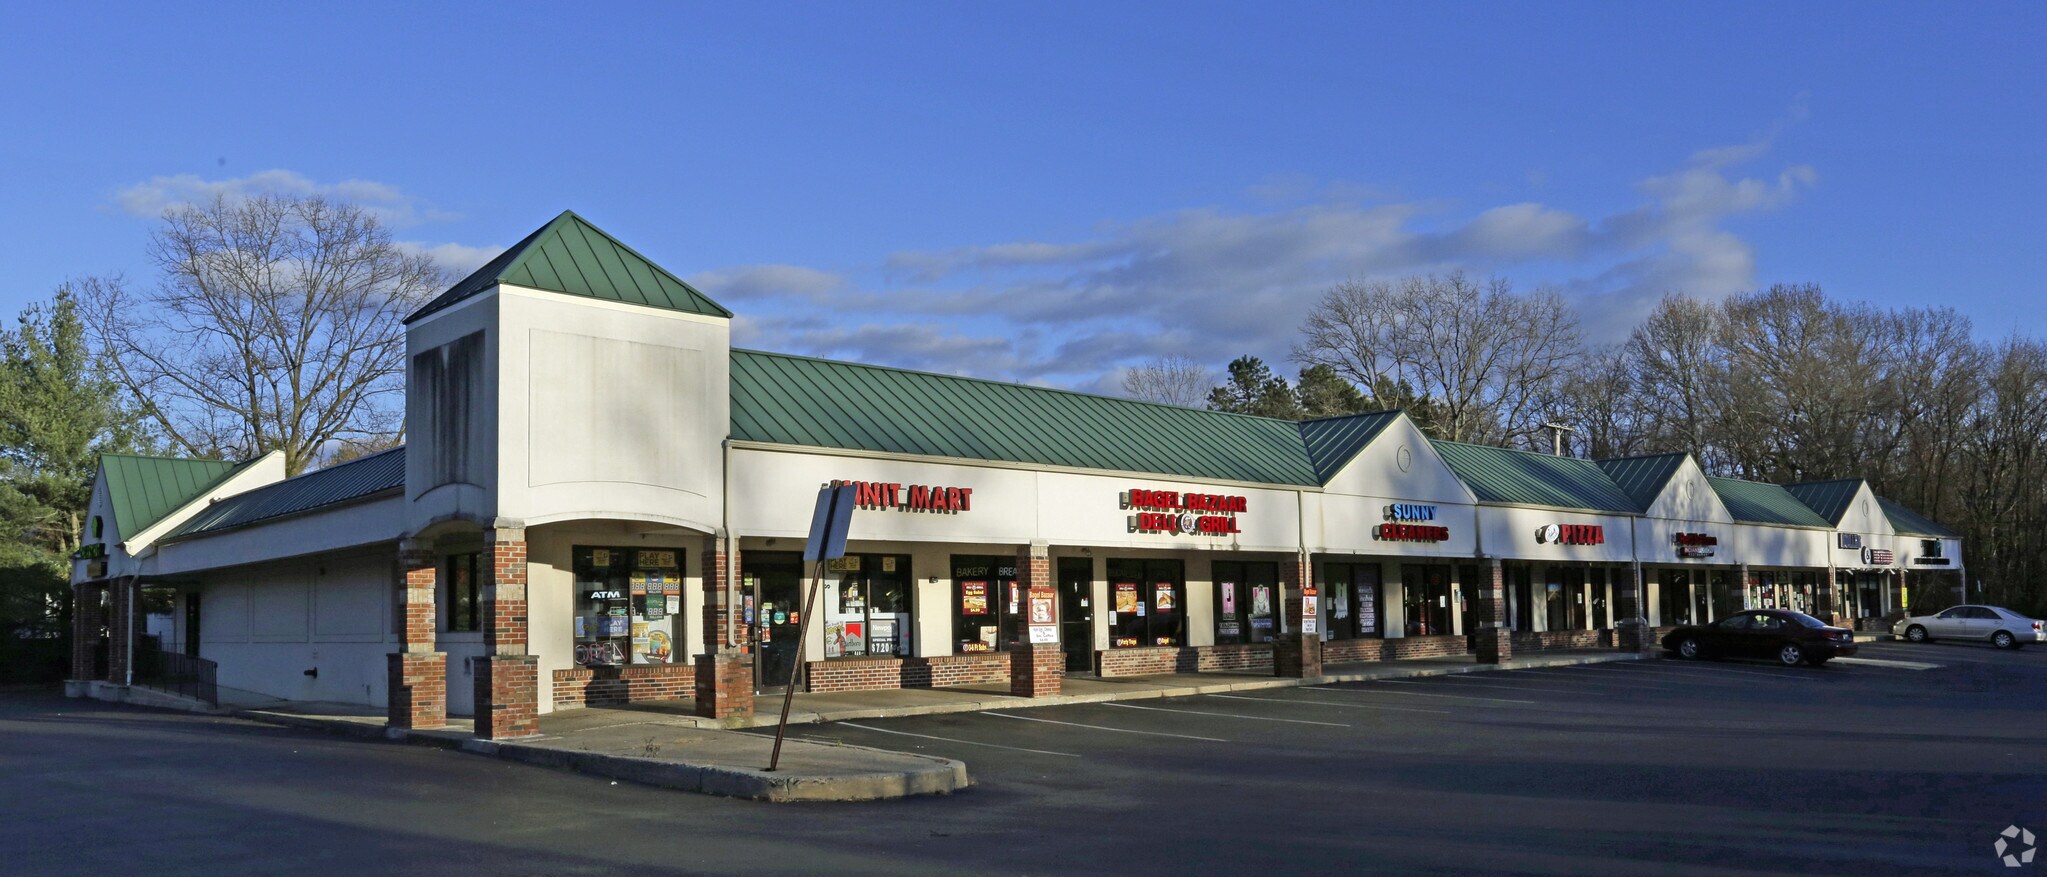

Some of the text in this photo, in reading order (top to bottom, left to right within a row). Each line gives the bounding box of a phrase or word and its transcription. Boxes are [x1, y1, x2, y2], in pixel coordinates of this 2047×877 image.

[910, 485, 972, 511] MART
[1131, 489, 1247, 512] BAGEL BAZAAR
[1393, 503, 1437, 520] SUNNY
[1139, 513, 1241, 533] DELI GRILL
[1382, 523, 1449, 540] CLEANERS
[1561, 524, 1604, 544] PIZZA
[956, 567, 988, 577] BAKERY
[590, 591, 620, 599] ATM
[575, 642, 628, 664] OPEN
